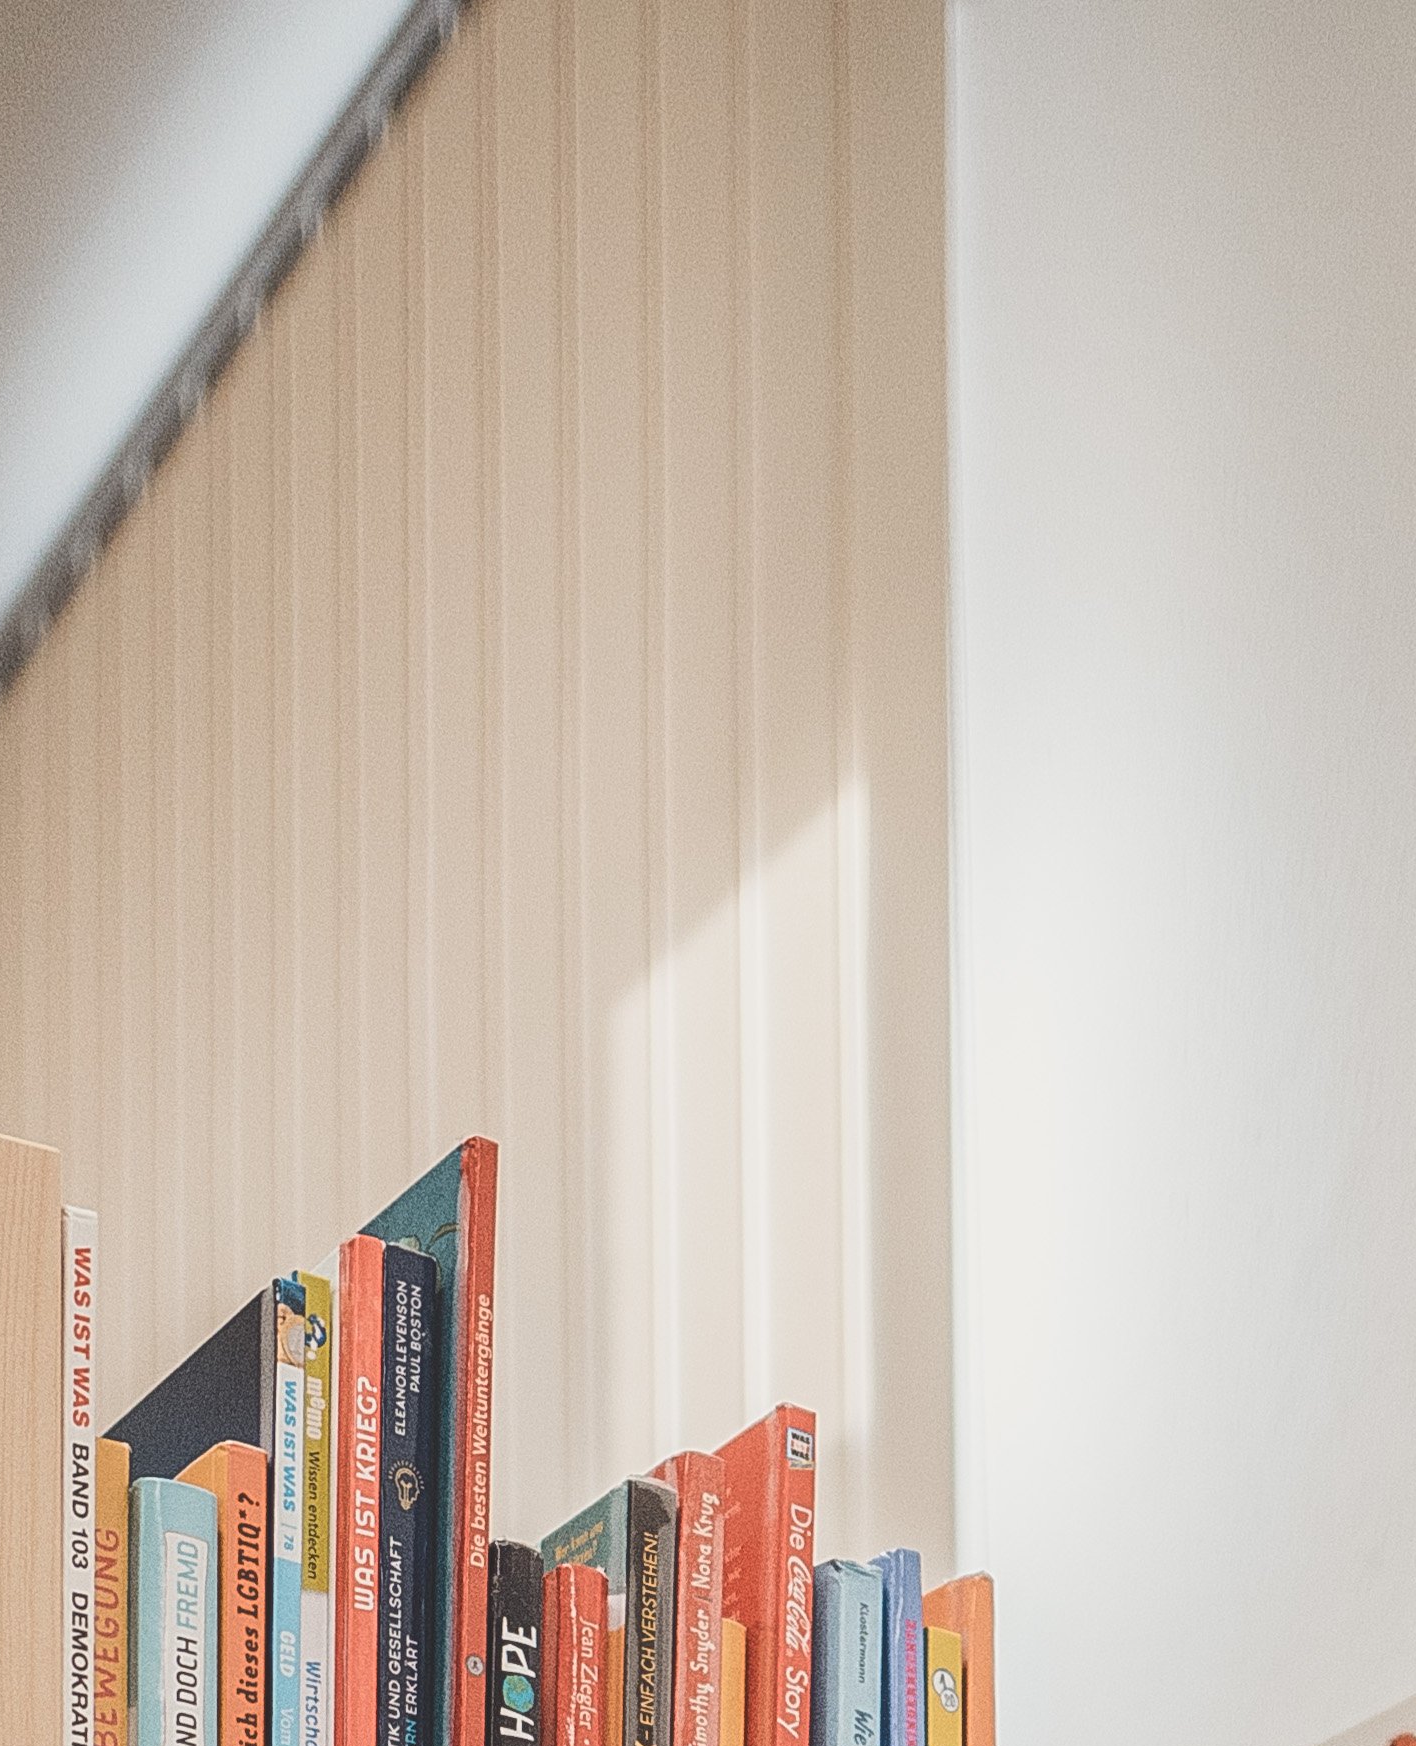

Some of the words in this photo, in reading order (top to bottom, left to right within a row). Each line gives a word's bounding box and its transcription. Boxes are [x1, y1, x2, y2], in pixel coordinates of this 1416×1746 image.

[73, 1246, 92, 1307] WAS
[73, 1313, 91, 1359] IST
[71, 1367, 90, 1428] WAS
[473, 1294, 491, 1468] Weltuntergänge
[357, 1376, 380, 1482] KRIEG?
[71, 1443, 89, 1519] BAND
[356, 1488, 378, 1536] IST
[694, 1491, 719, 1546] Krug
[788, 1503, 812, 1549] Die
[353, 1542, 376, 1611] WAS
[641, 1533, 659, 1647] VERSTEHEN!
[177, 1637, 199, 1705] DOCH
[238, 1628, 259, 1704] dieses
[405, 1635, 419, 1716] ERKLÄRT
[691, 1606, 717, 1675] Snyder
[858, 1602, 868, 1684] Klostermann
[503, 1617, 537, 1743] HOPE
[577, 1670, 598, 1733] Ziegler
[639, 1651, 654, 1726] EINFACH
[777, 1665, 808, 1738] Story
